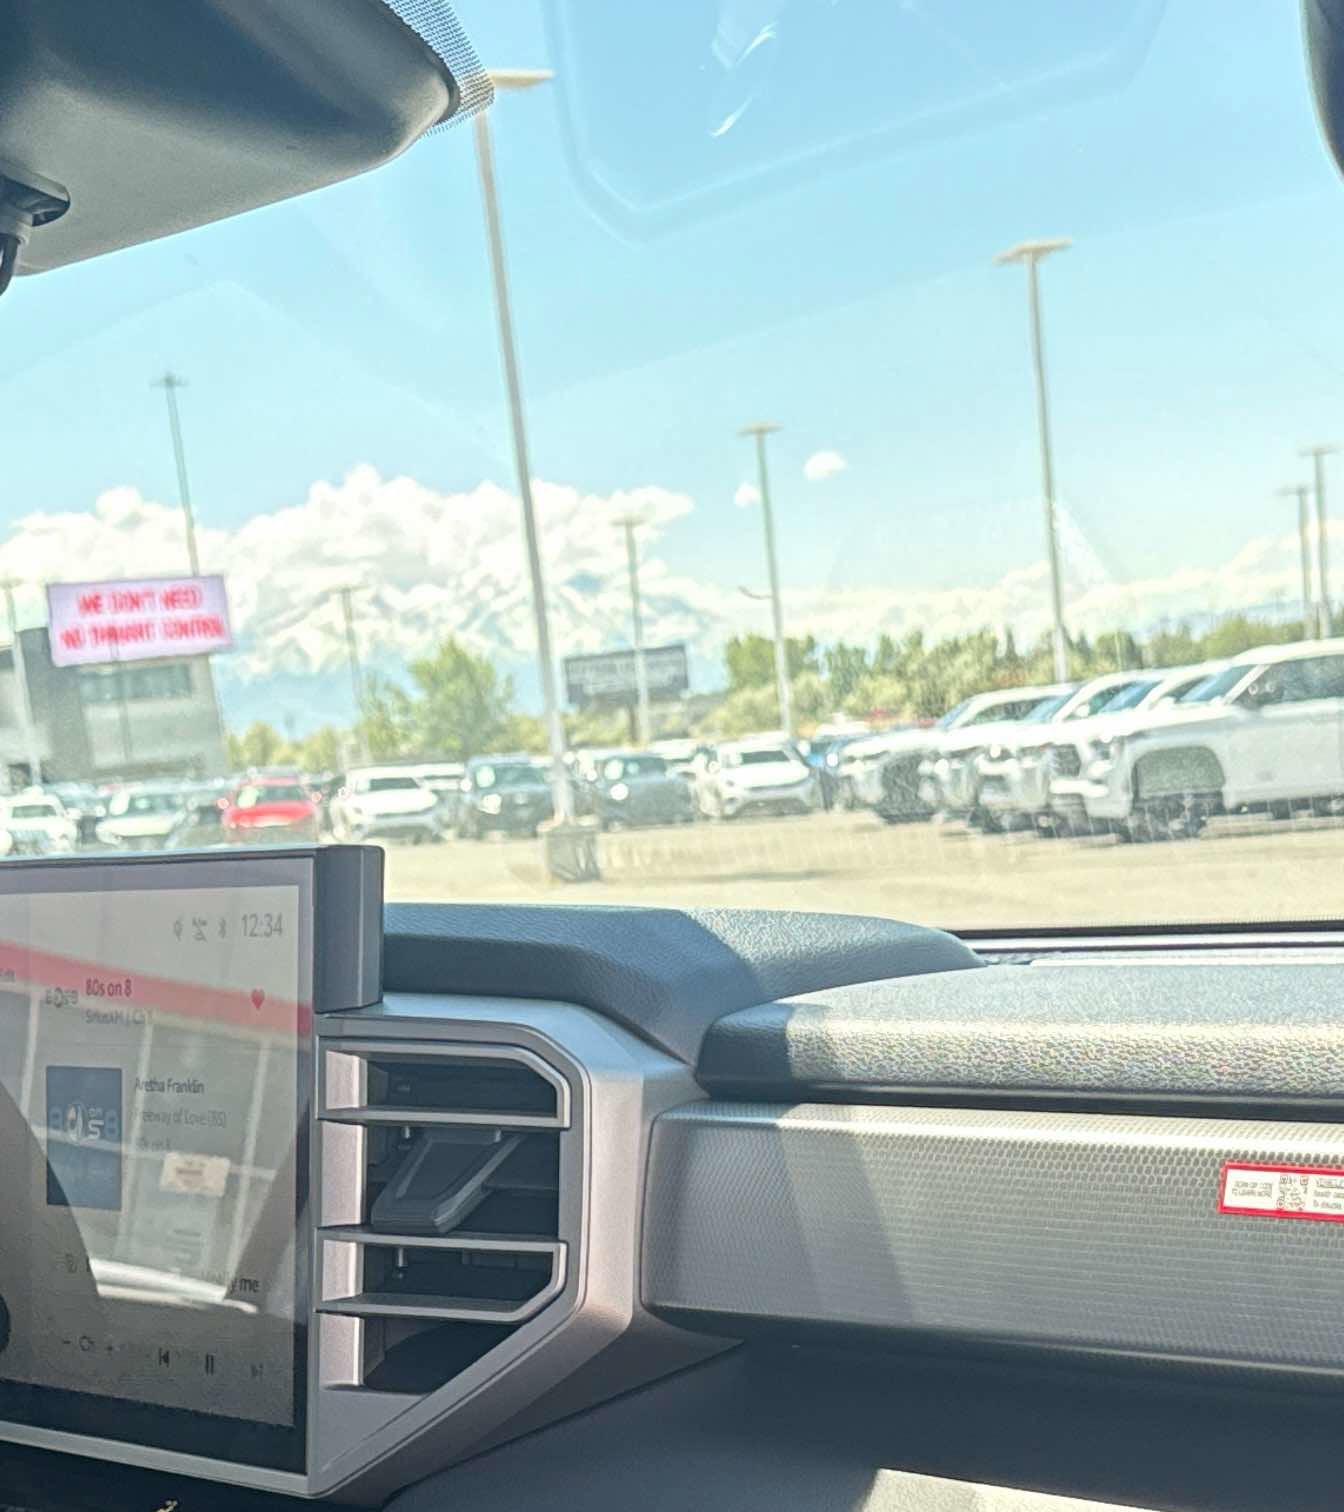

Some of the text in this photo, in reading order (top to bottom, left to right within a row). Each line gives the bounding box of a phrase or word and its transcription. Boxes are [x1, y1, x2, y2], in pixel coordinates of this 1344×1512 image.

[241, 913, 283, 938] 12:34
[86, 979, 133, 998] 80s on 8
[167, 1078, 205, 1095] Franklin
